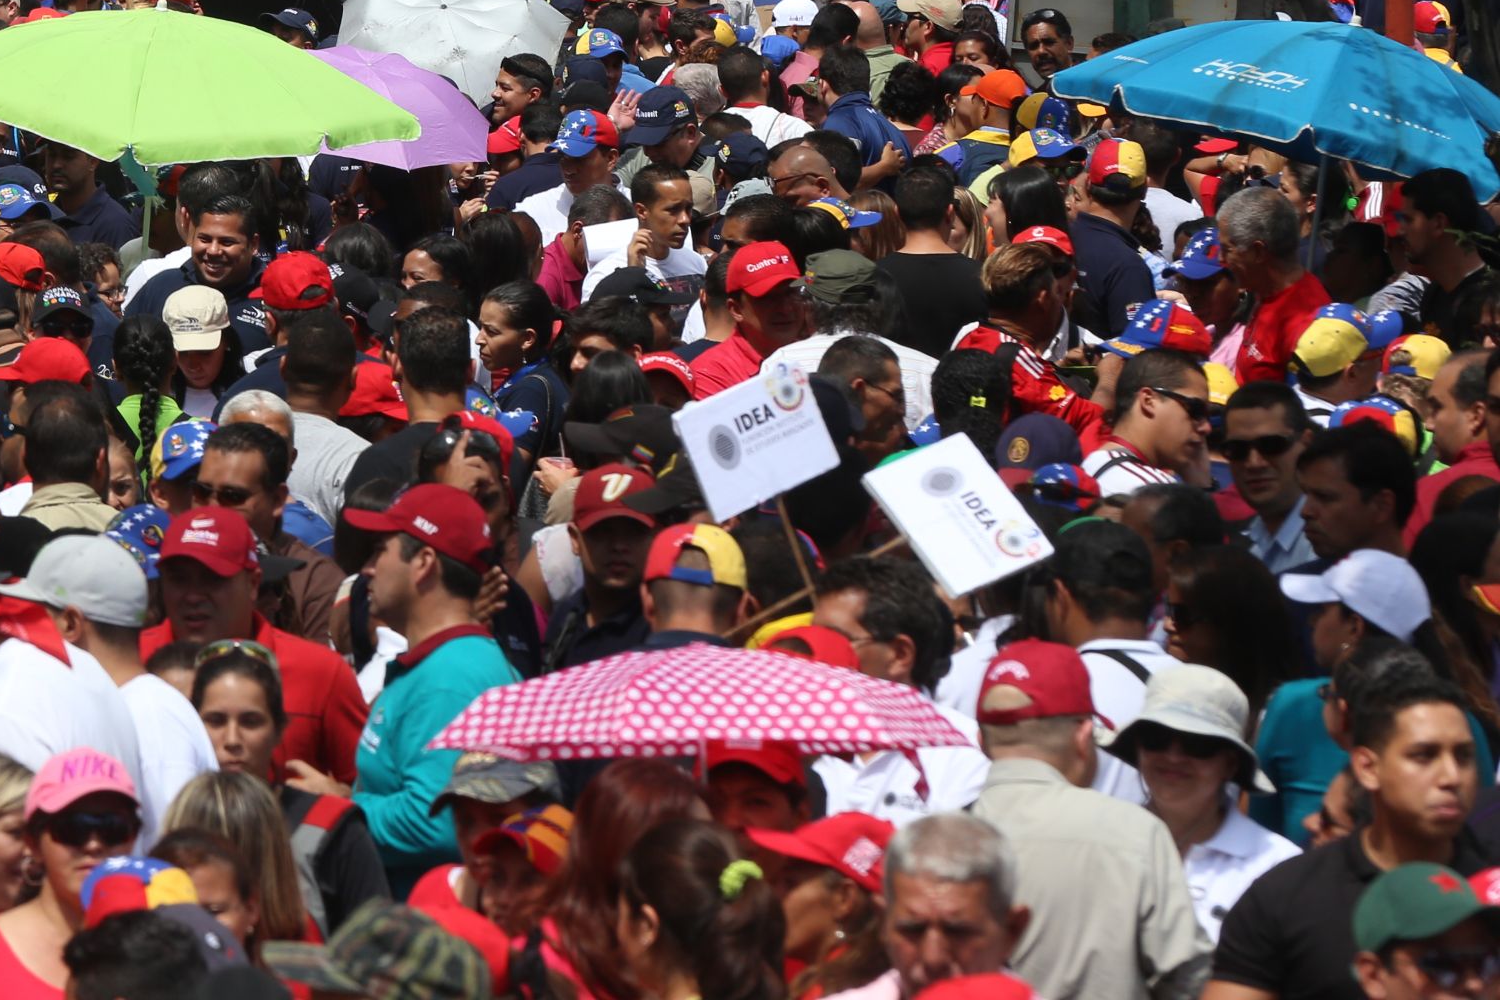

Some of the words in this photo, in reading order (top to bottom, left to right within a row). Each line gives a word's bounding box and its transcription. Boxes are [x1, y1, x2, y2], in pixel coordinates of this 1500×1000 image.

[746, 258, 778, 272] Cuatro
[733, 403, 776, 435] IDEA
[960, 490, 997, 531] IDEA
